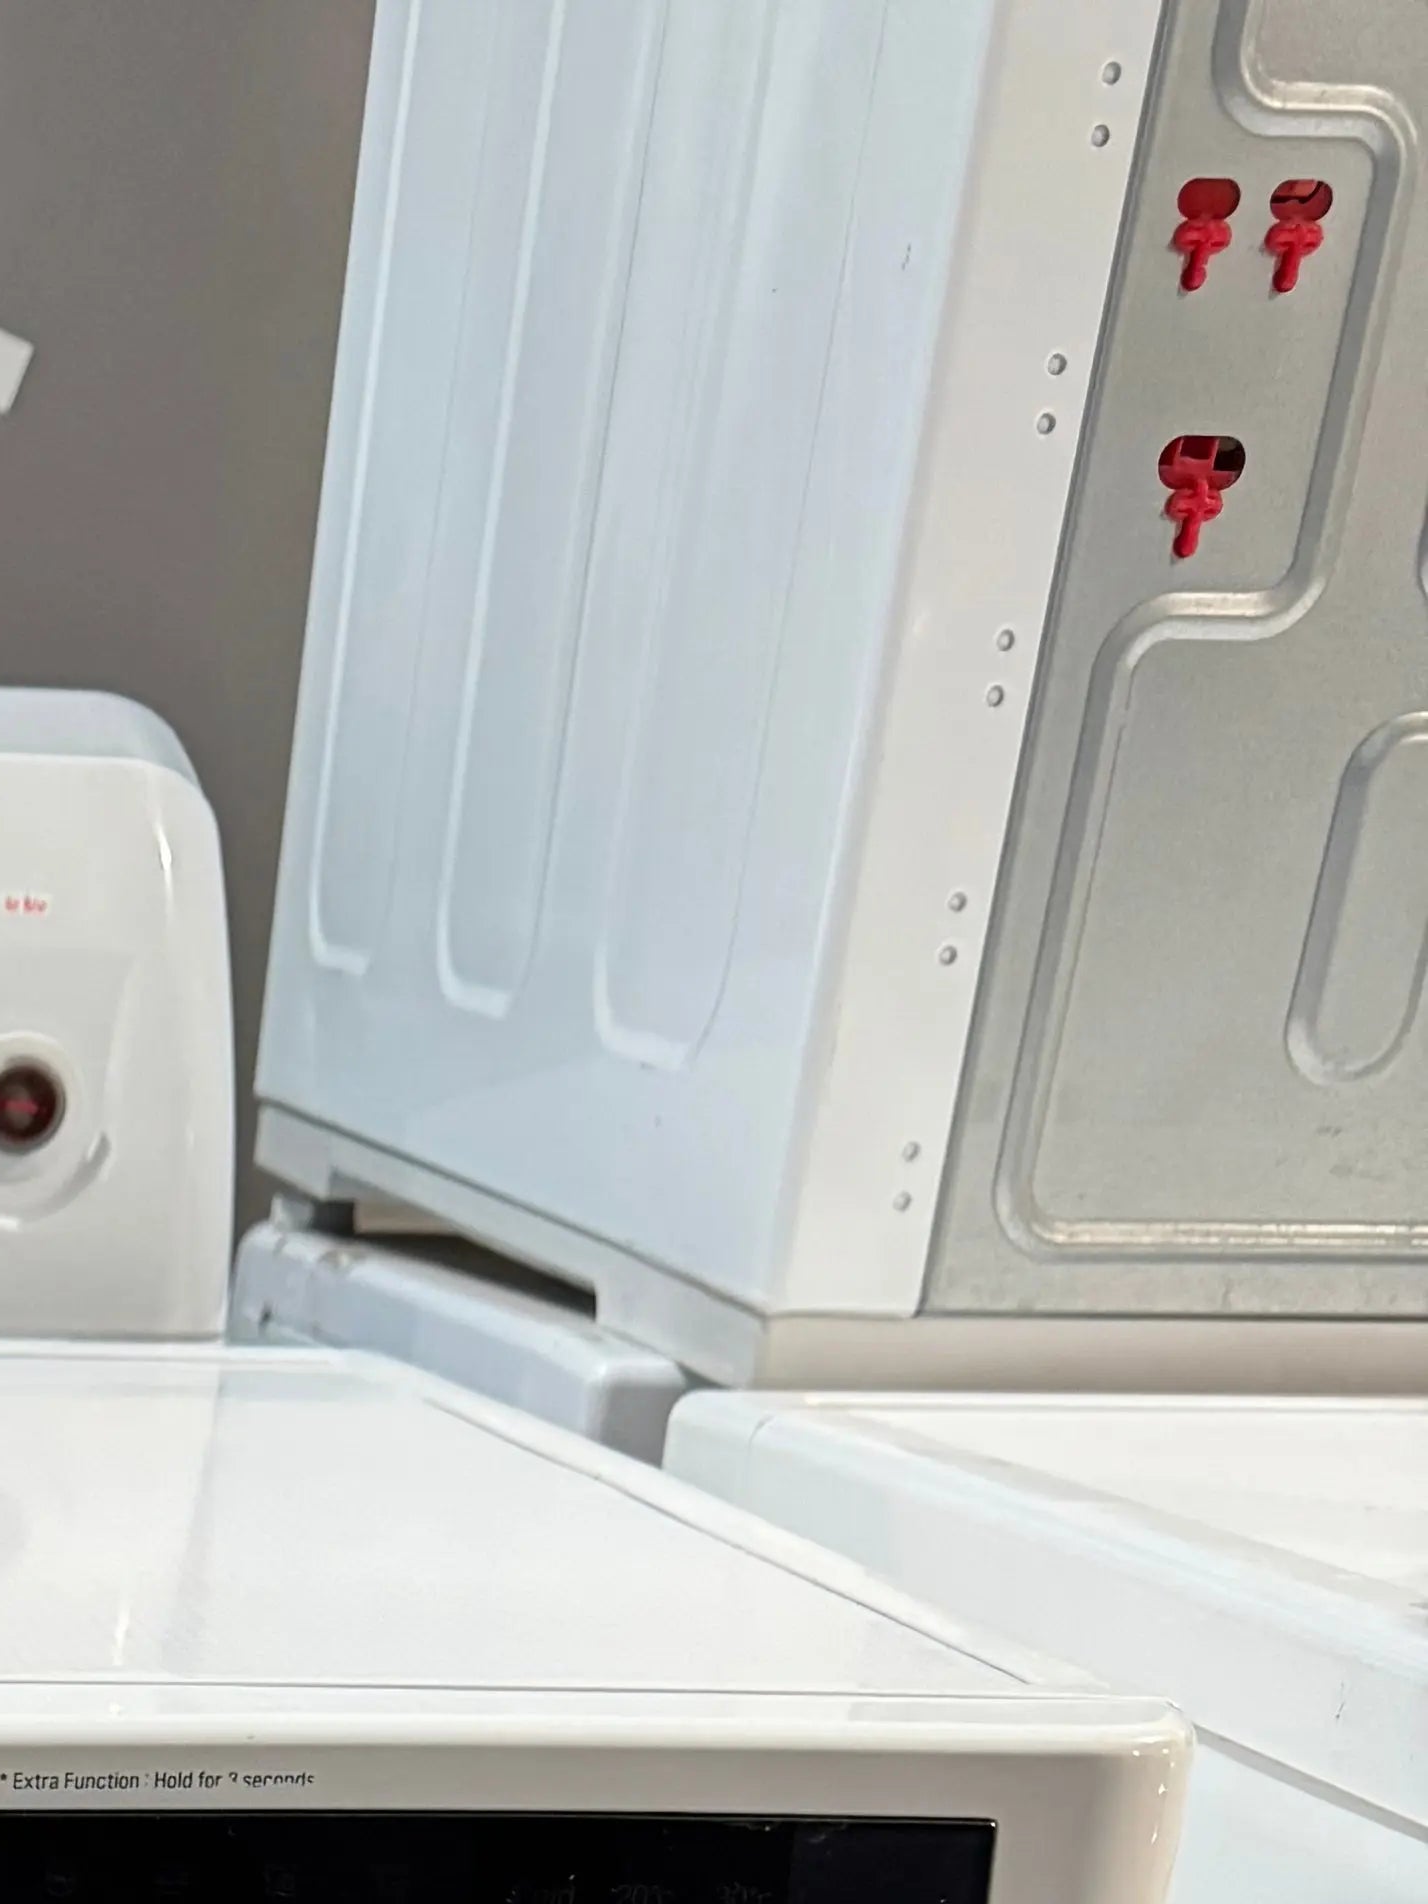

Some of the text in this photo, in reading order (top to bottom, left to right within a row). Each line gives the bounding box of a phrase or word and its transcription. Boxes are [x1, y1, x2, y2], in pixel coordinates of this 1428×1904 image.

[13, 1773, 59, 1790] Extra
[64, 1773, 139, 1789] Function
[154, 1772, 193, 1789] Hold
[198, 1772, 223, 1788] for
